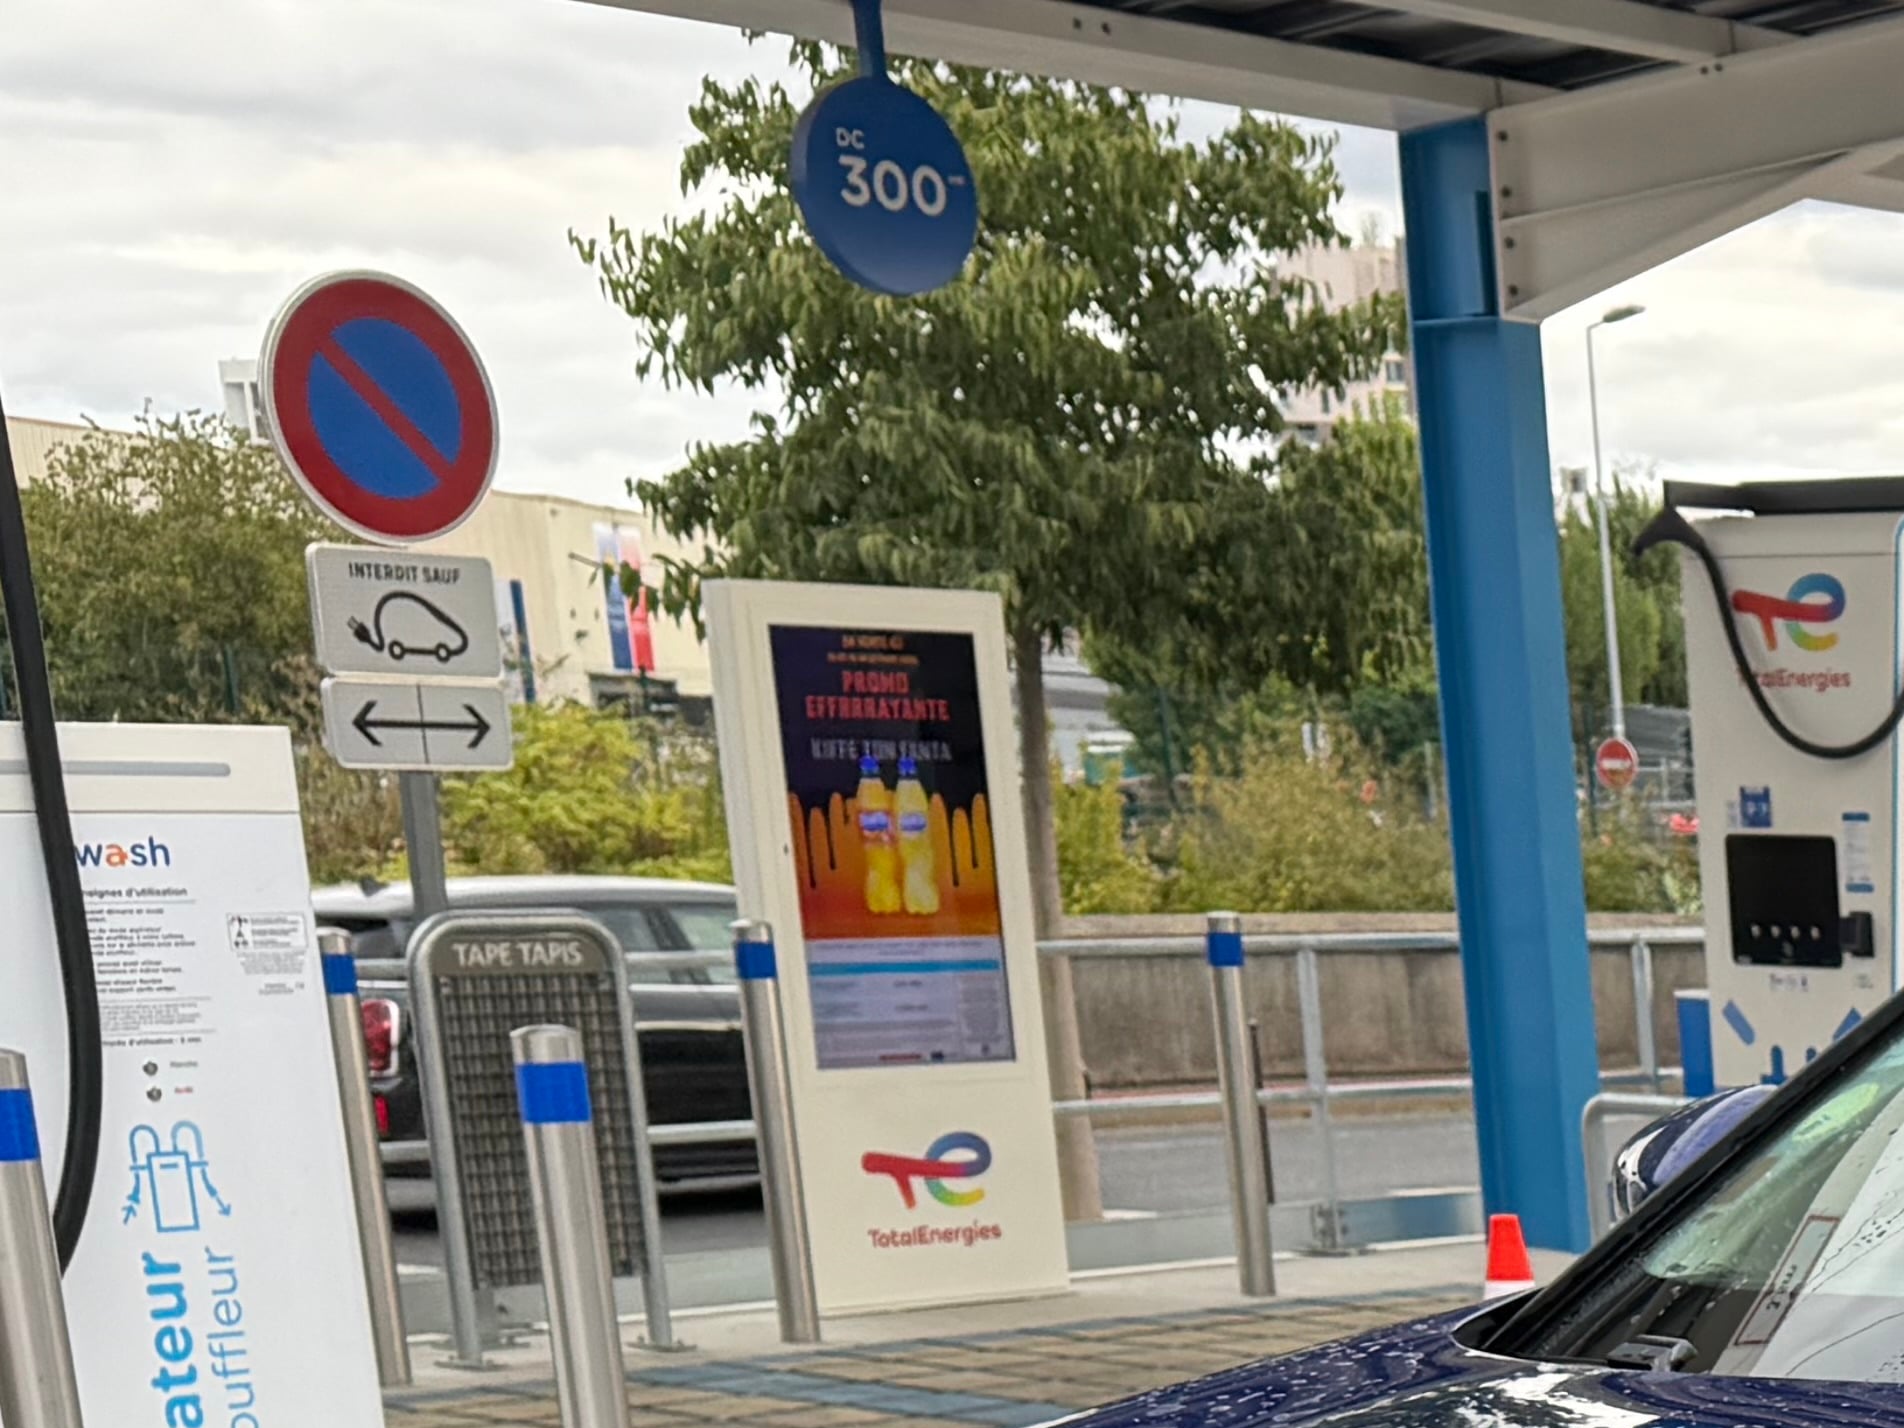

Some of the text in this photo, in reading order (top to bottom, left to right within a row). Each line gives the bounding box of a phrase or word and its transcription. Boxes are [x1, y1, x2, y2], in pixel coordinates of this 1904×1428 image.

[836, 127, 864, 149] DC
[838, 154, 947, 217] 300
[348, 562, 460, 584] INTERDIT SAUF
[842, 670, 909, 694] PROMO
[75, 836, 170, 867] wash
[452, 940, 583, 966] TAPE TAPIS
[867, 1218, 1002, 1247] TotalEnergies
